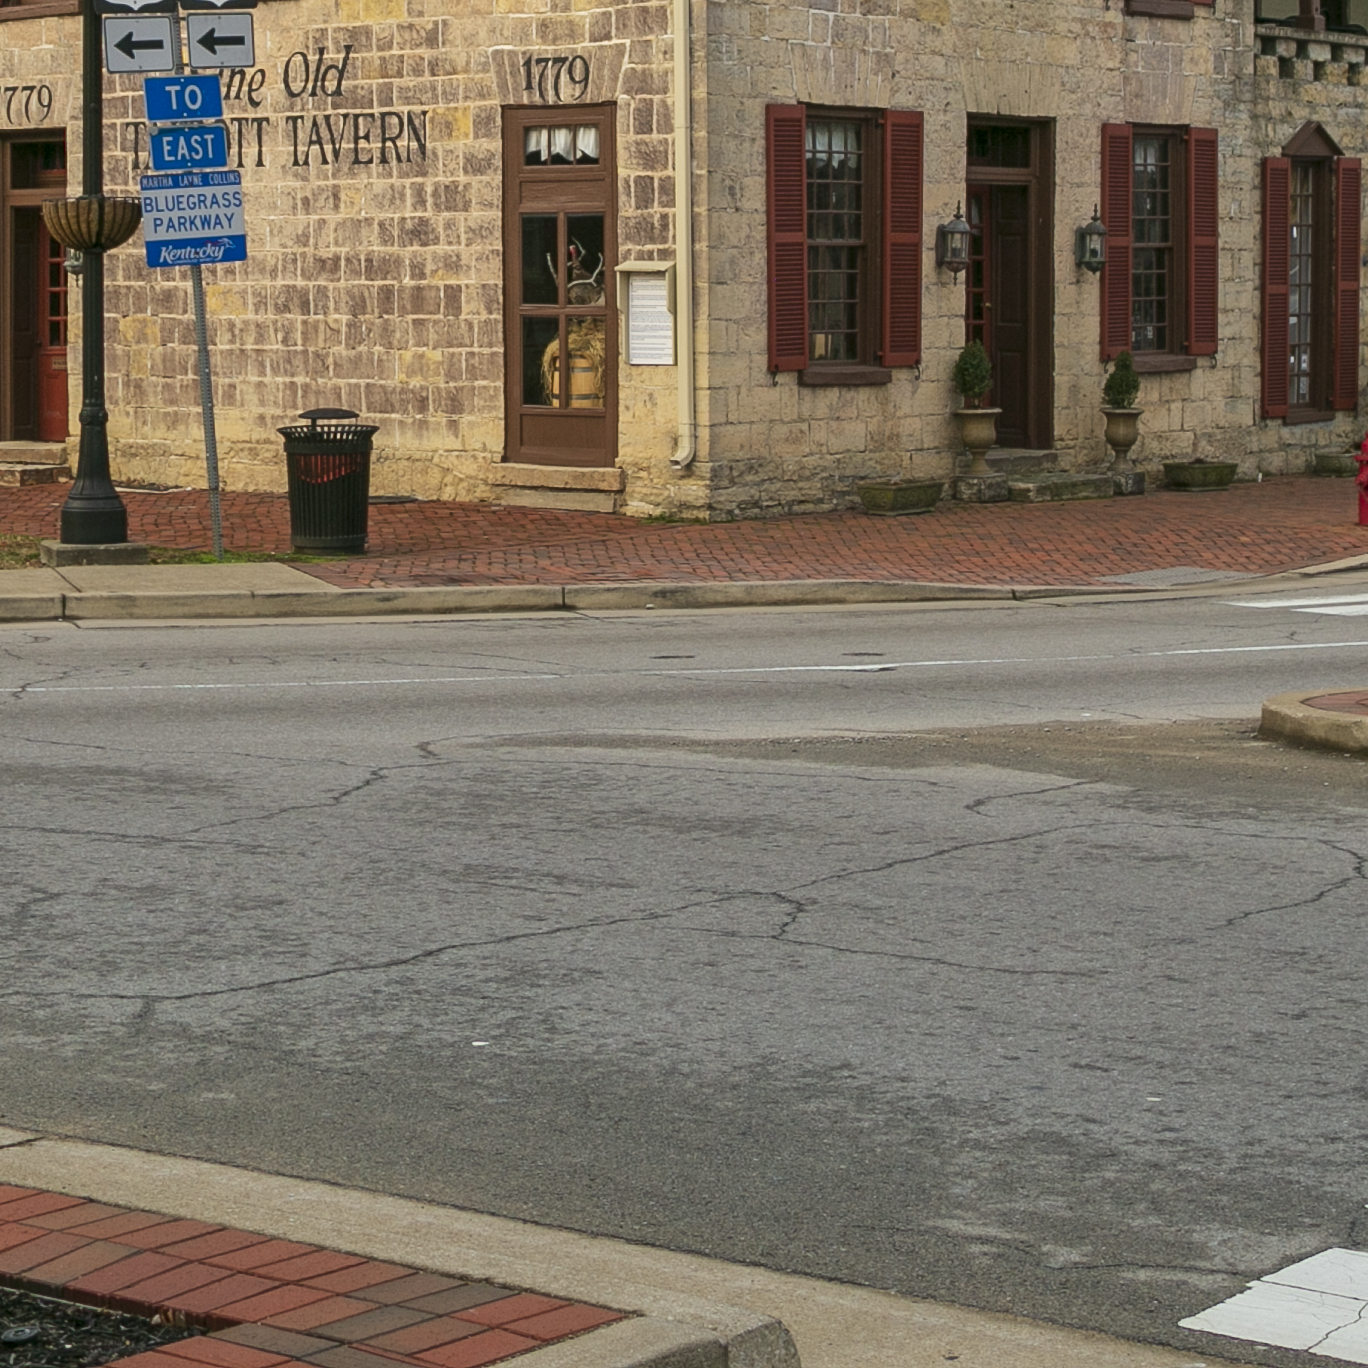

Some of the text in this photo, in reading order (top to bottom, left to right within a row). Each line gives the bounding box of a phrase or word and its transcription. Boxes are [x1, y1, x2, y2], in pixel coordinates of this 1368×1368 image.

[283, 43, 354, 99] Old
[521, 53, 590, 103] 1779
[165, 85, 202, 110] TO
[162, 134, 215, 161] EAST
[285, 111, 429, 168] TAVERN
[142, 172, 240, 188] MARTHA LAYNE COLLINS
[143, 191, 242, 213] BLUEGRASS
[153, 212, 234, 234] PARKWAY
[159, 243, 225, 264] Kentucky
